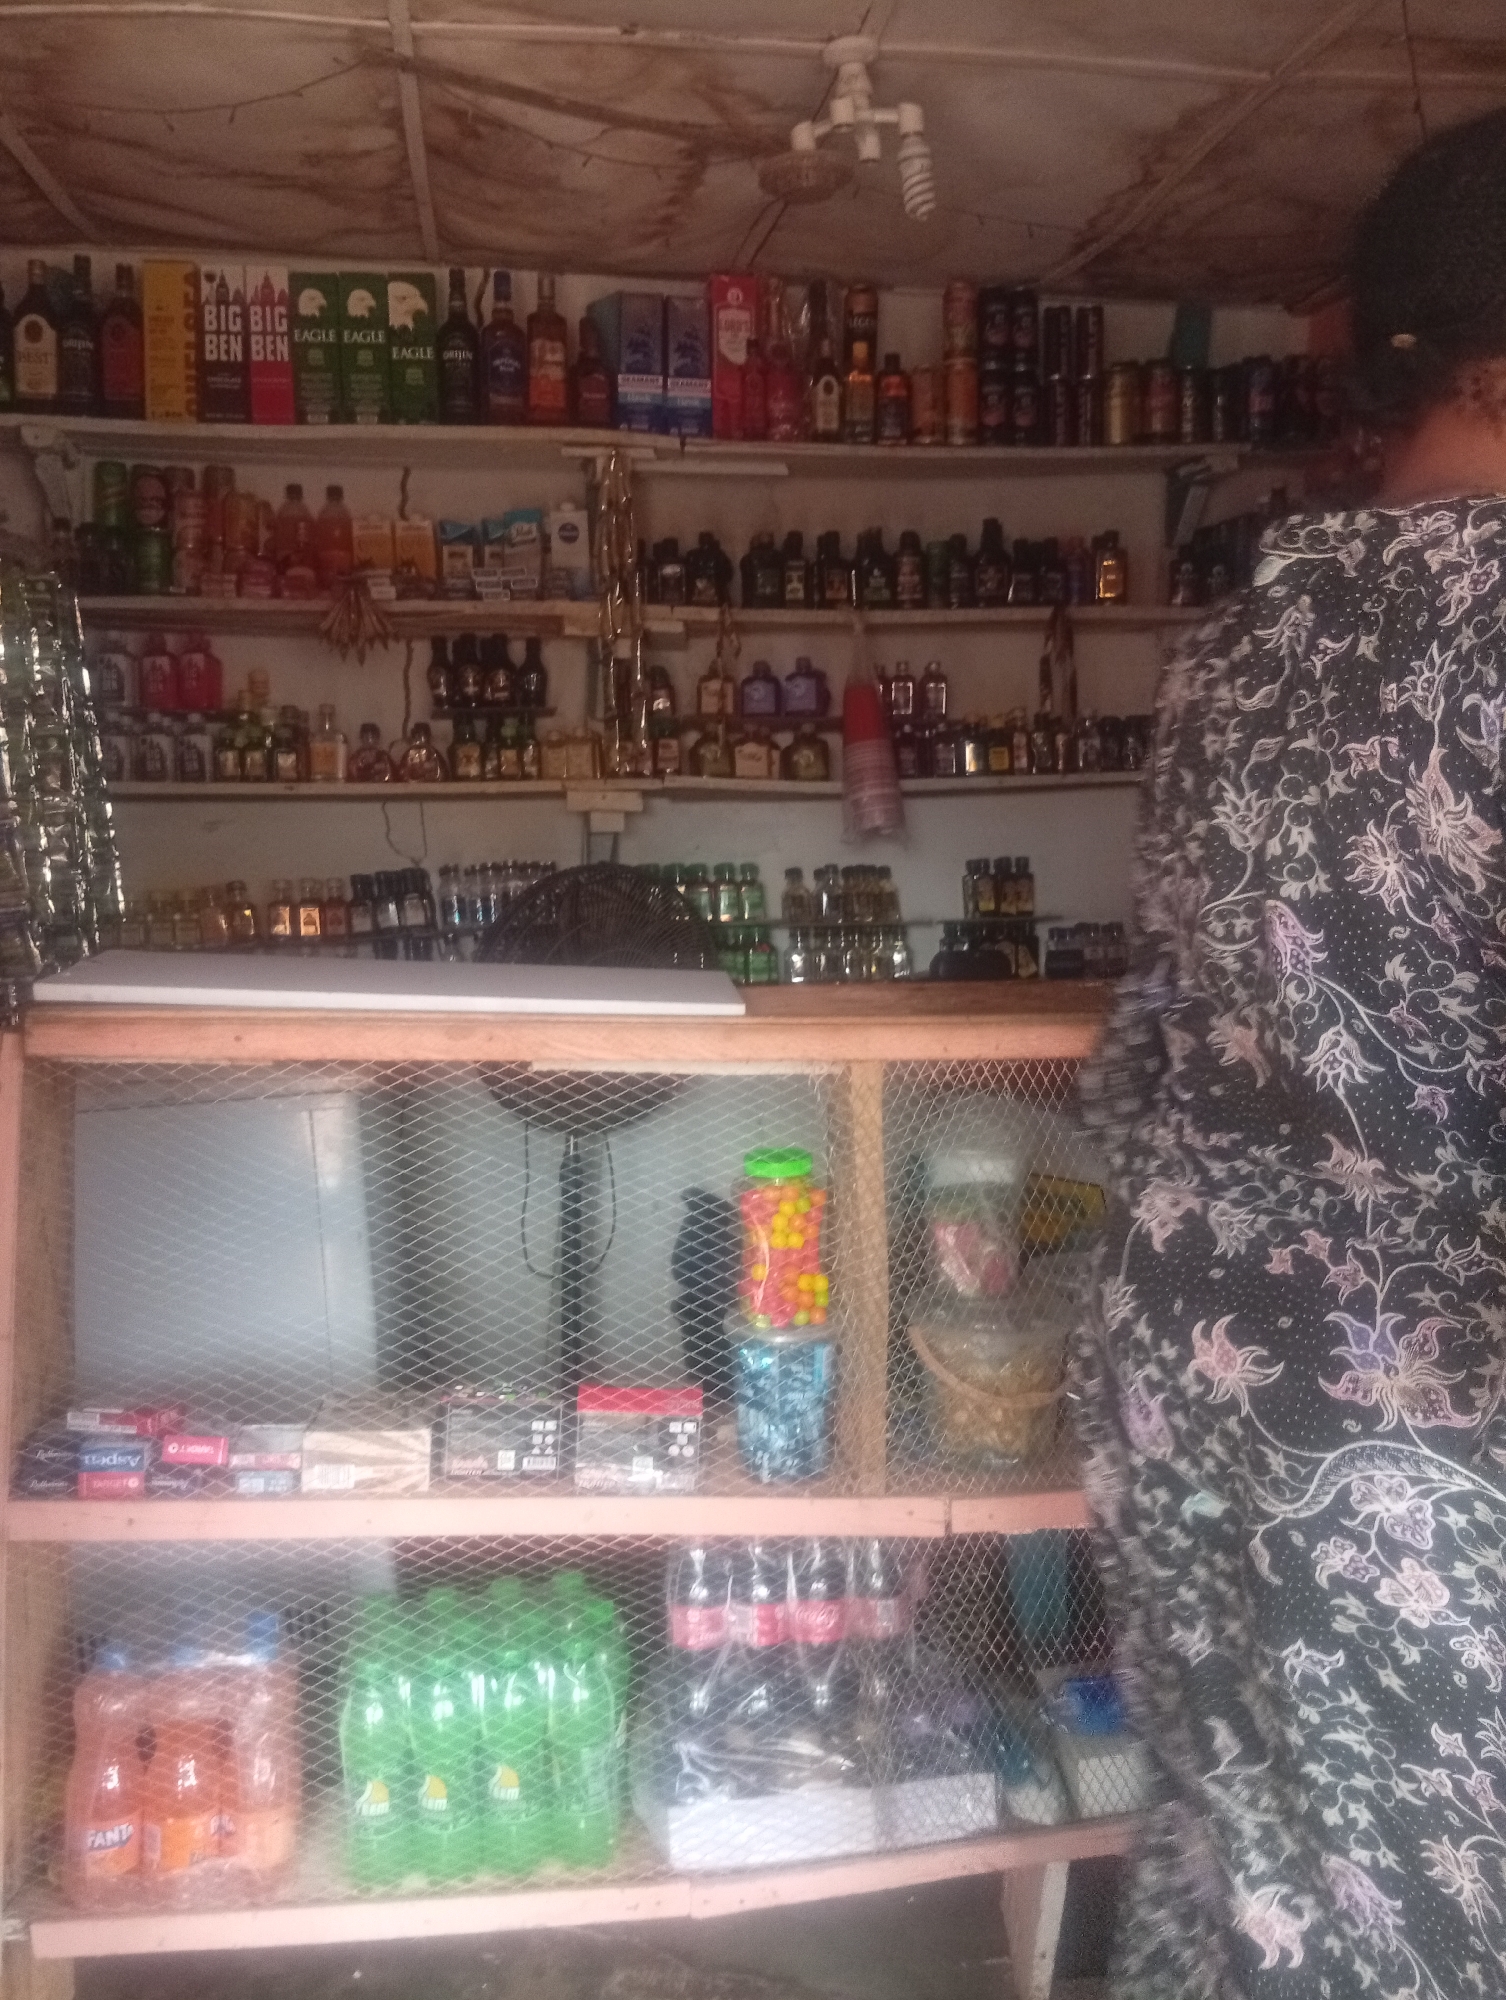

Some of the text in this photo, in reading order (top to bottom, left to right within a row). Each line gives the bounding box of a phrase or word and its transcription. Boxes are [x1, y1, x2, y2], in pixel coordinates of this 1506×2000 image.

[204, 305, 242, 332] BIG
[250, 305, 288, 332] BIG
[294, 329, 336, 343] EAGLE
[343, 329, 385, 344] EAGLE
[204, 333, 243, 361] BEN
[250, 334, 289, 361] BEN
[392, 346, 434, 360] EAGLE
[84, 1453, 142, 1468] Aspen
